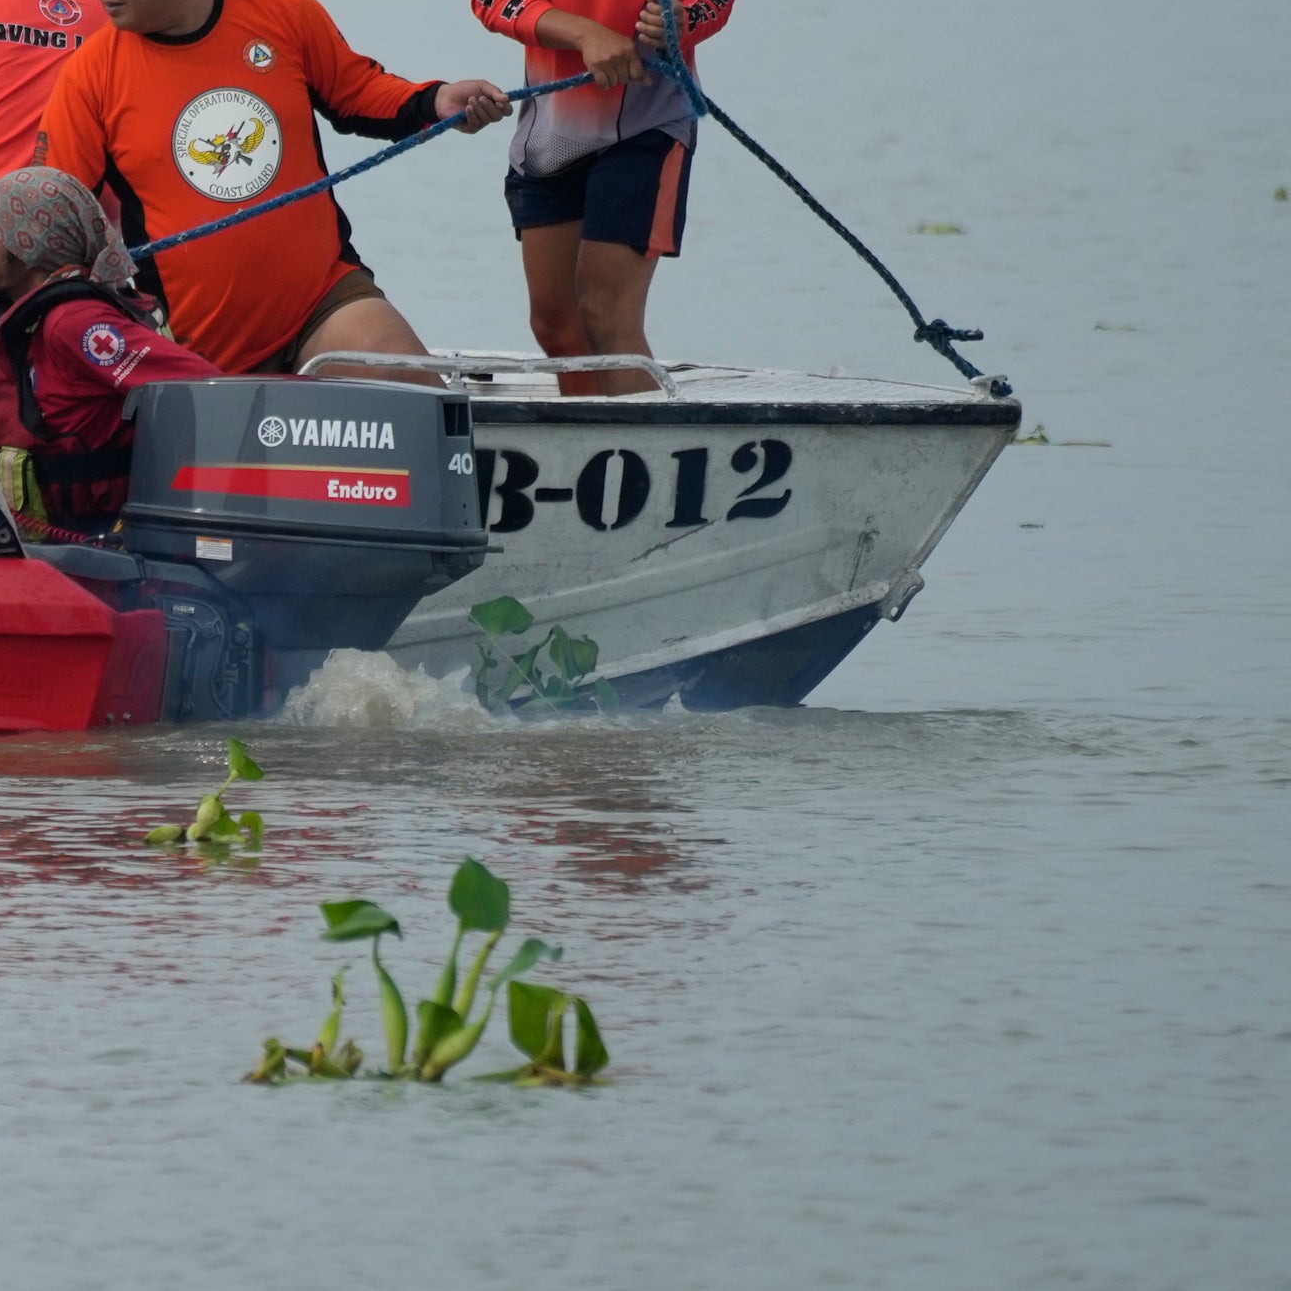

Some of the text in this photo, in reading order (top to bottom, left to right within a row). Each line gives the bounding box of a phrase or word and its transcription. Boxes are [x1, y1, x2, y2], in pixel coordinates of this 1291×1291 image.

[176, 92, 275, 158] SPECIAL OPERATIONS FORCE
[209, 163, 275, 198] COAST GUARD
[82, 324, 110, 352] PHILIPPINE
[112, 349, 139, 377] NATIONAL
[288, 418, 395, 450] YAMAHA
[448, 452, 474, 475] 40
[327, 479, 397, 501] Enduro
